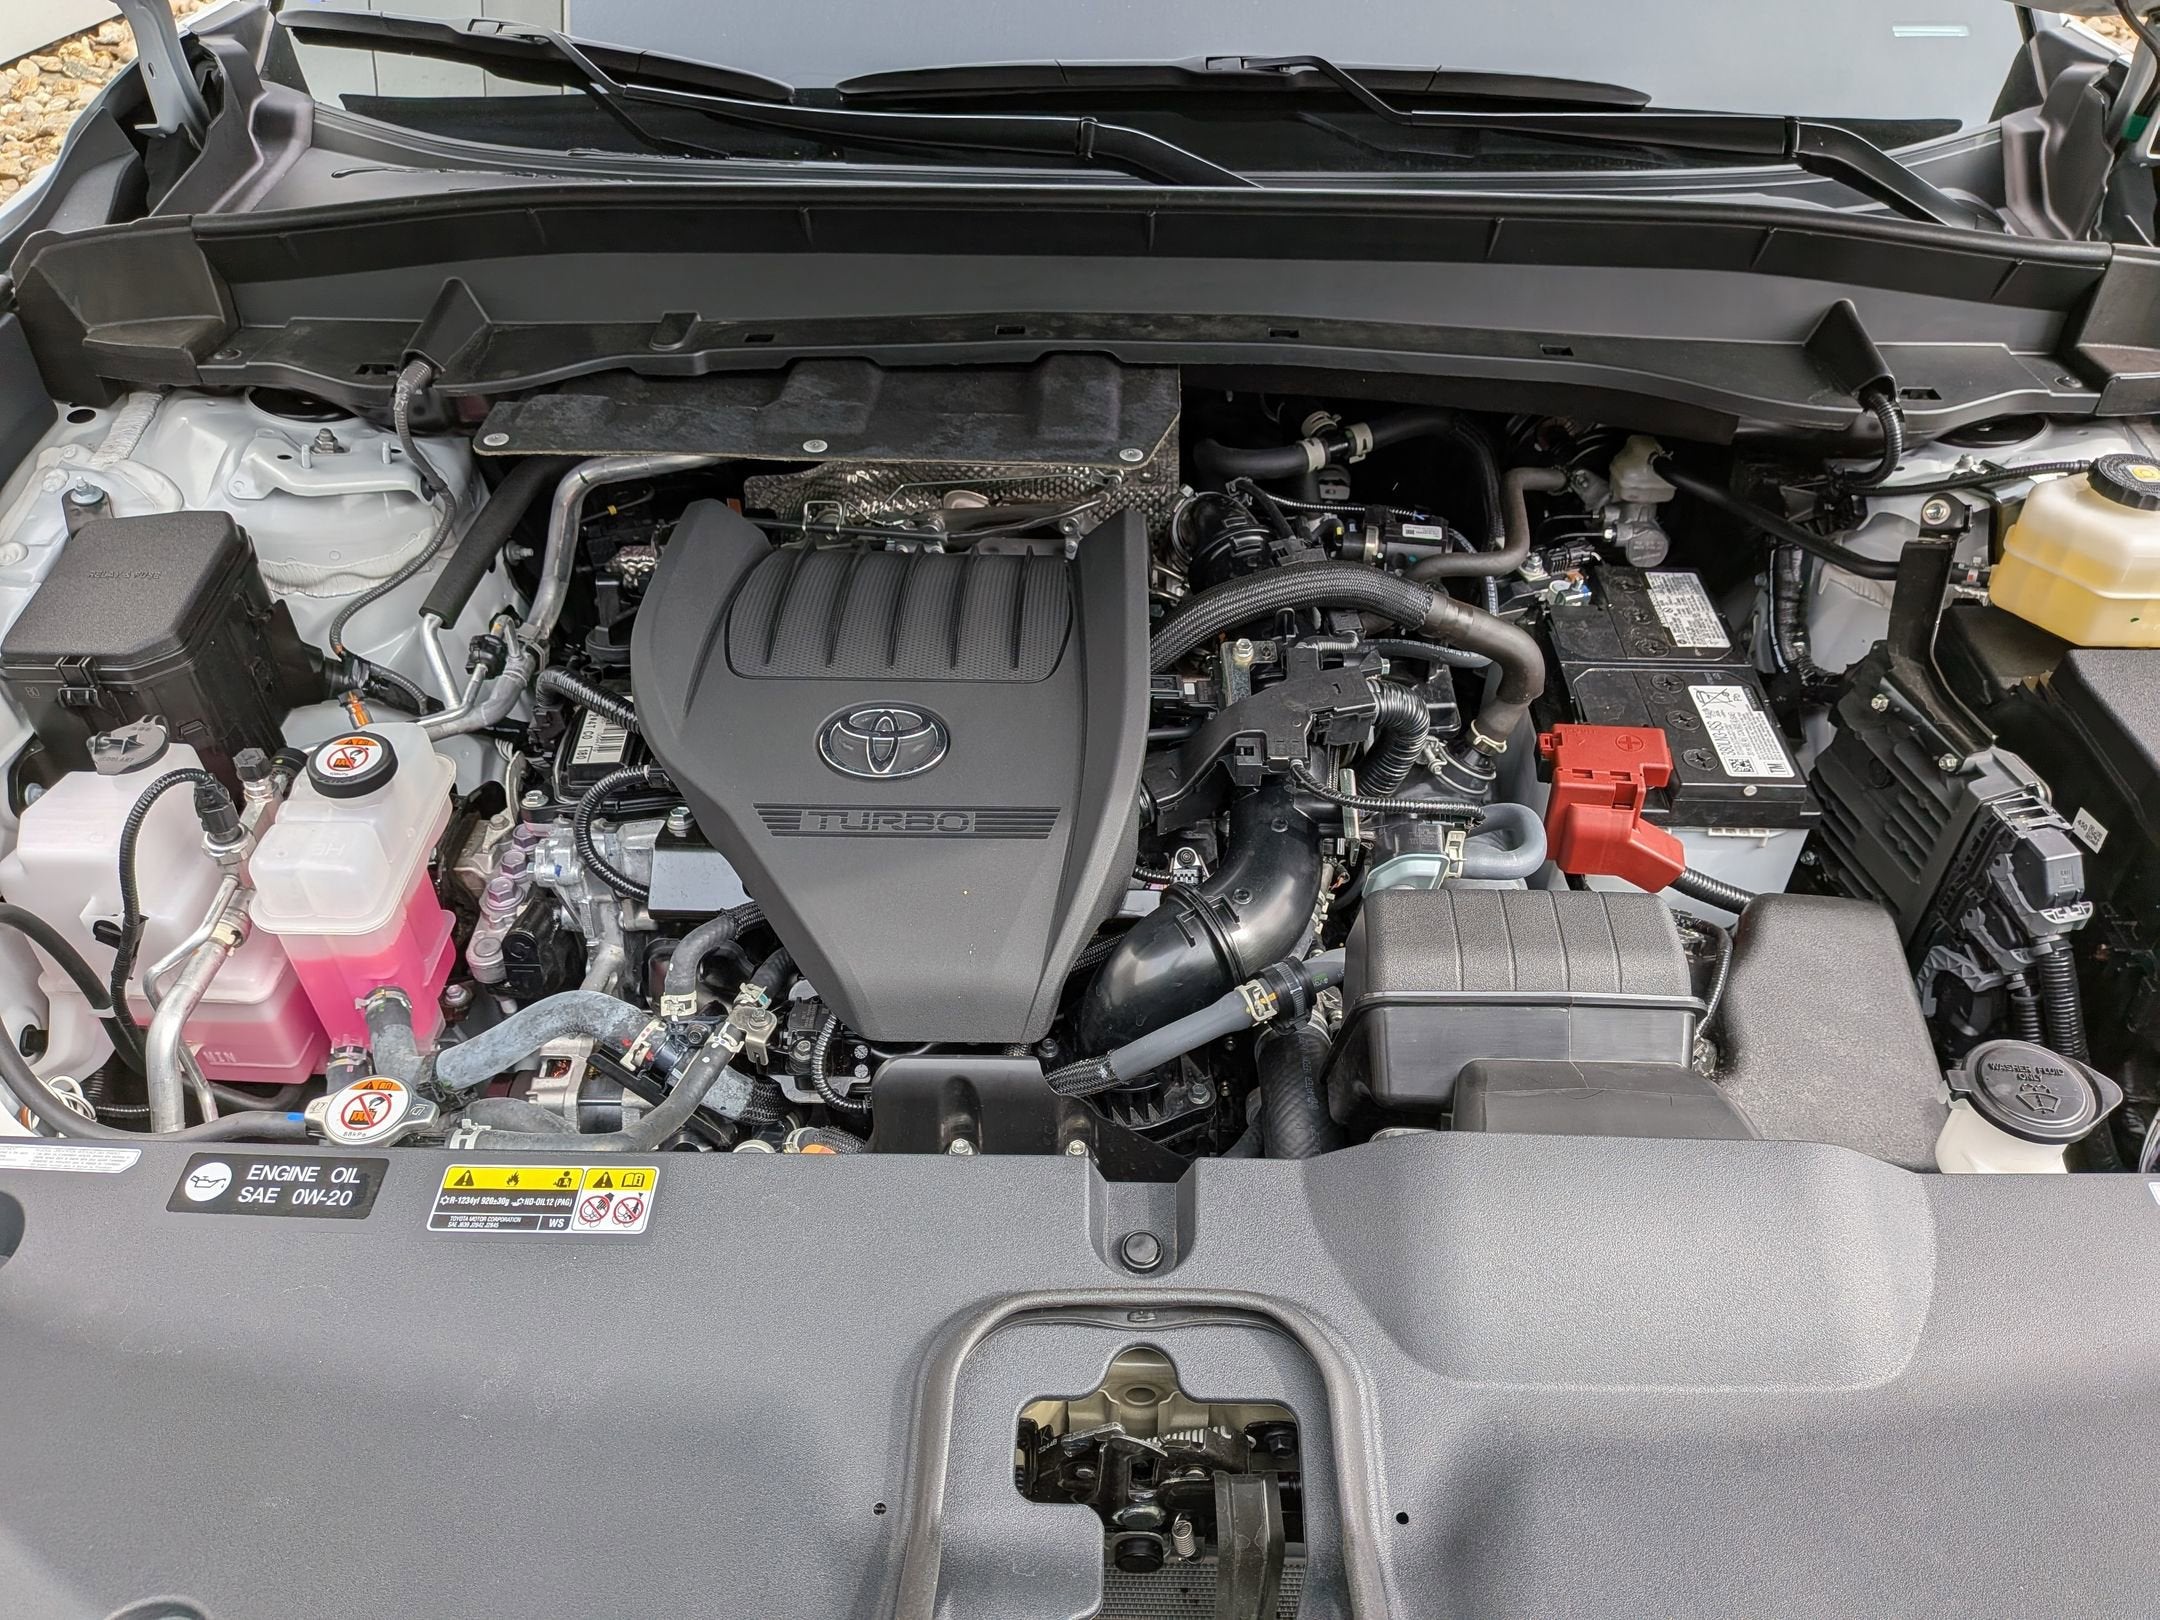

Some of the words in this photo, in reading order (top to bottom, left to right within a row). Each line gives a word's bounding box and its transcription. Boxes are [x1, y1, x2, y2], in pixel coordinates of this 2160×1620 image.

[806, 810, 970, 832] TURBO
[203, 1051, 237, 1063] MIN
[1987, 1062, 2032, 1073] WASHER
[2035, 1066, 2065, 1077] FLUID
[2016, 1073, 2043, 1082] ONLY
[246, 1164, 320, 1182] ENGINE
[330, 1166, 361, 1183] OIL
[237, 1186, 280, 1204] SAE
[291, 1188, 353, 1206] 0W-20
[448, 1196, 480, 1205] R-1234yf
[554, 1198, 573, 1208] (PAG)
[548, 1218, 565, 1228] WS
